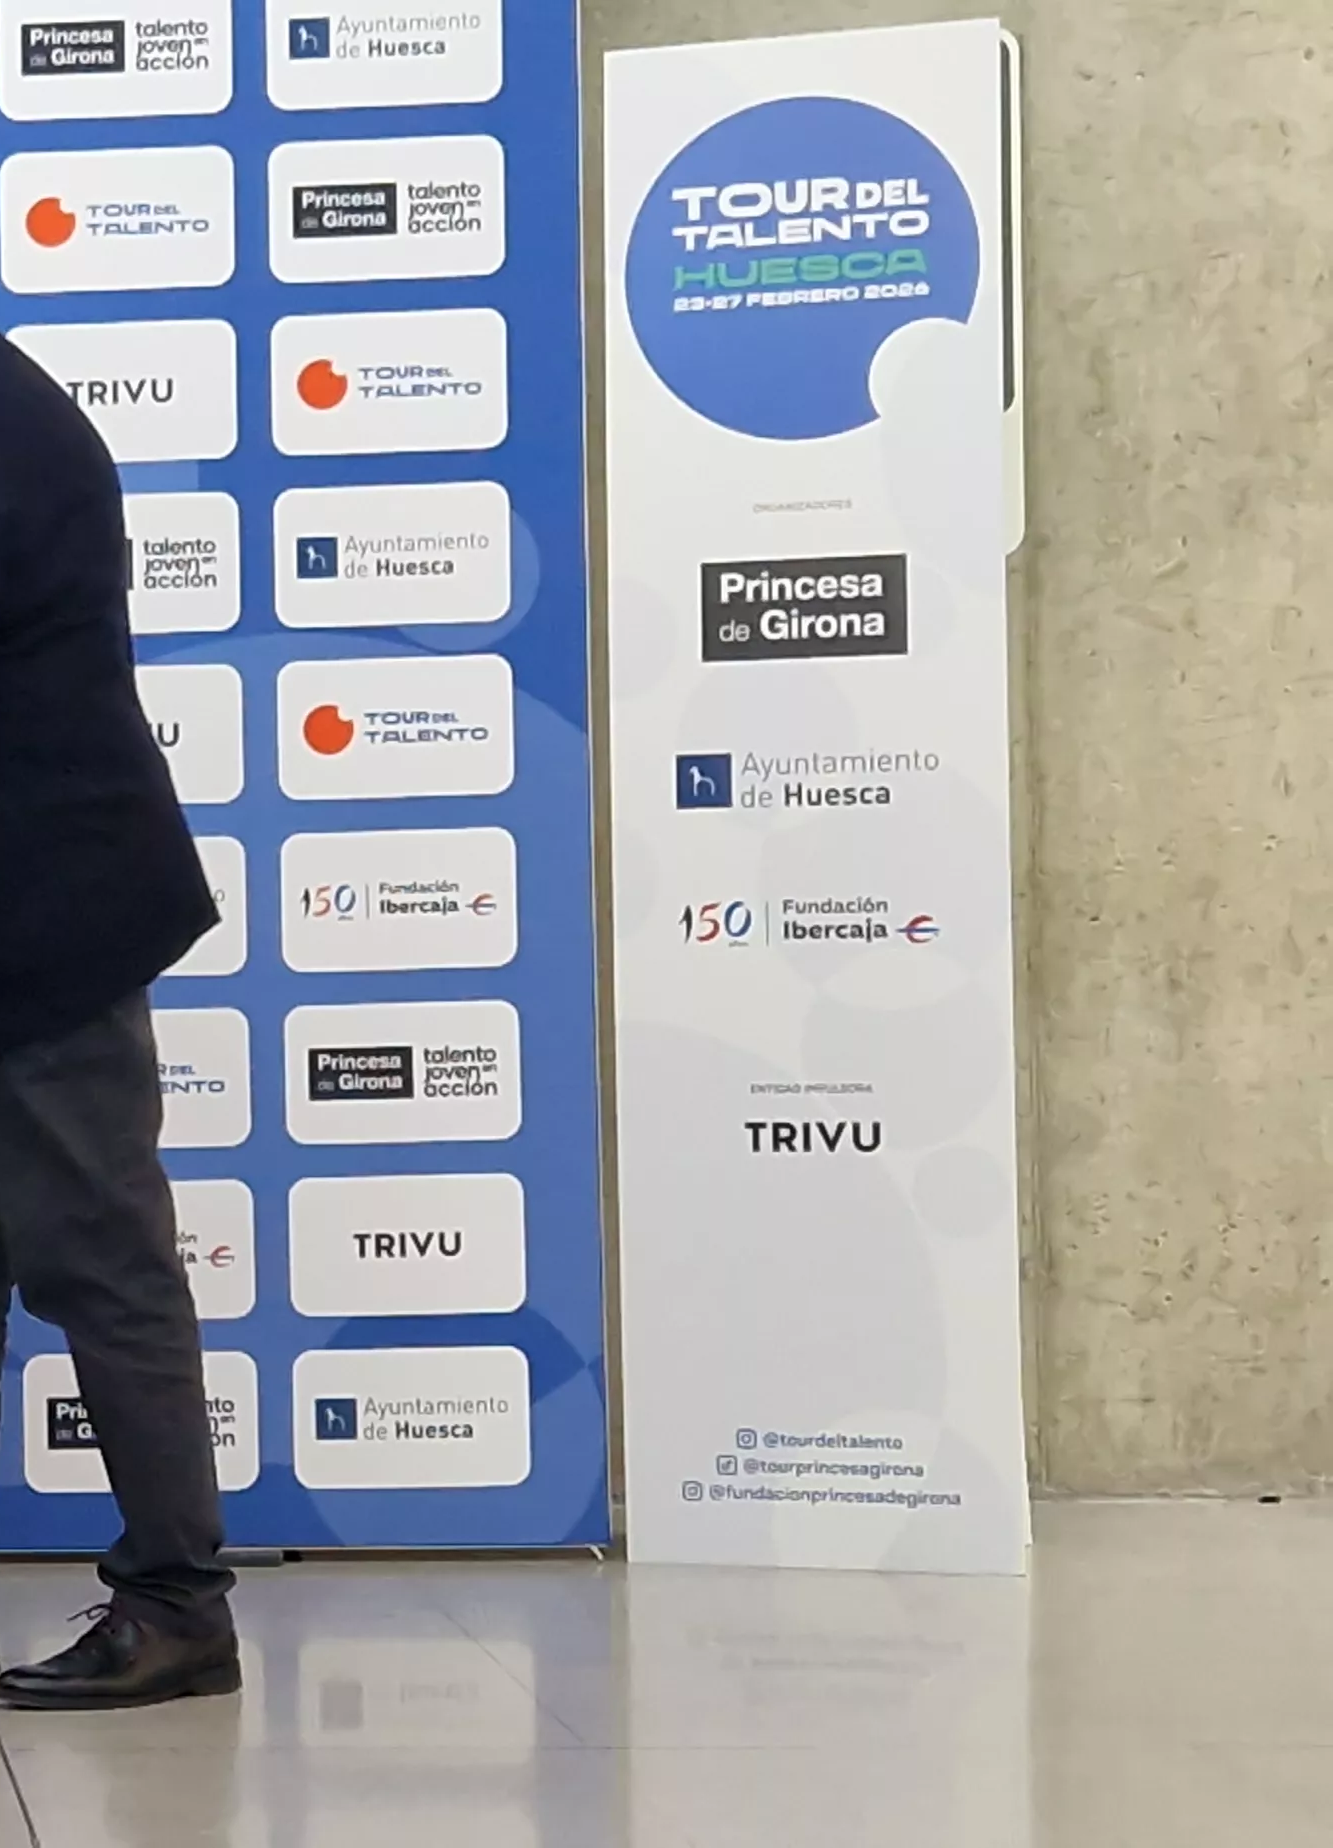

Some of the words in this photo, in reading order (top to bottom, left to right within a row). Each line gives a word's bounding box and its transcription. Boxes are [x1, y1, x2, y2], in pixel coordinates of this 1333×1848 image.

[135, 19, 209, 38] talento
[336, 11, 480, 37] Ayuntamiento
[30, 28, 114, 46] Princesa
[50, 48, 115, 66] Girona
[137, 38, 192, 58] joven
[336, 40, 361, 59] de
[367, 38, 446, 58] Huesca
[301, 190, 386, 209] Princesa
[407, 181, 480, 200] talento
[671, 176, 850, 222] TOUR
[856, 178, 929, 209] DEL
[86, 203, 153, 217] TOUR
[408, 200, 464, 219] joven
[86, 220, 209, 236] TALENTO
[321, 210, 387, 229] Girona
[671, 210, 929, 251] TALENTO
[673, 248, 927, 291] HUESCA
[673, 295, 742, 313] 23-27
[746, 286, 859, 308] FEBRERO
[358, 366, 423, 379] TOUR
[67, 378, 174, 407] TRIVU
[358, 382, 481, 399] TALENTO
[143, 538, 216, 556] talento
[344, 532, 490, 557] Ayuntamiento
[144, 556, 200, 575] joven
[344, 560, 369, 579] de
[376, 557, 454, 577] Huesca
[719, 571, 883, 604] Princesa
[719, 619, 750, 642] de
[760, 608, 885, 641] Girona
[364, 711, 430, 724] TOUR
[364, 728, 488, 744] TALENTO
[740, 748, 939, 781] Ayuntamiento
[740, 785, 773, 808] de
[783, 782, 890, 808] Huesca
[300, 886, 356, 919] 150
[379, 898, 459, 916] Ibercaja
[783, 896, 888, 915] Fundación
[678, 900, 752, 944] 150
[783, 918, 888, 944] Ibercaja
[318, 1053, 402, 1071] Princesa
[424, 1045, 497, 1064] talento
[339, 1073, 403, 1090] Girona
[424, 1065, 481, 1083] joven
[744, 1121, 881, 1153] TRIVU
[353, 1232, 462, 1258] TRIVU
[364, 1396, 509, 1421] Ayuntamiento
[364, 1422, 387, 1441] de
[394, 1420, 474, 1440] Huesca
[763, 1432, 903, 1450] @tourdeltalento
